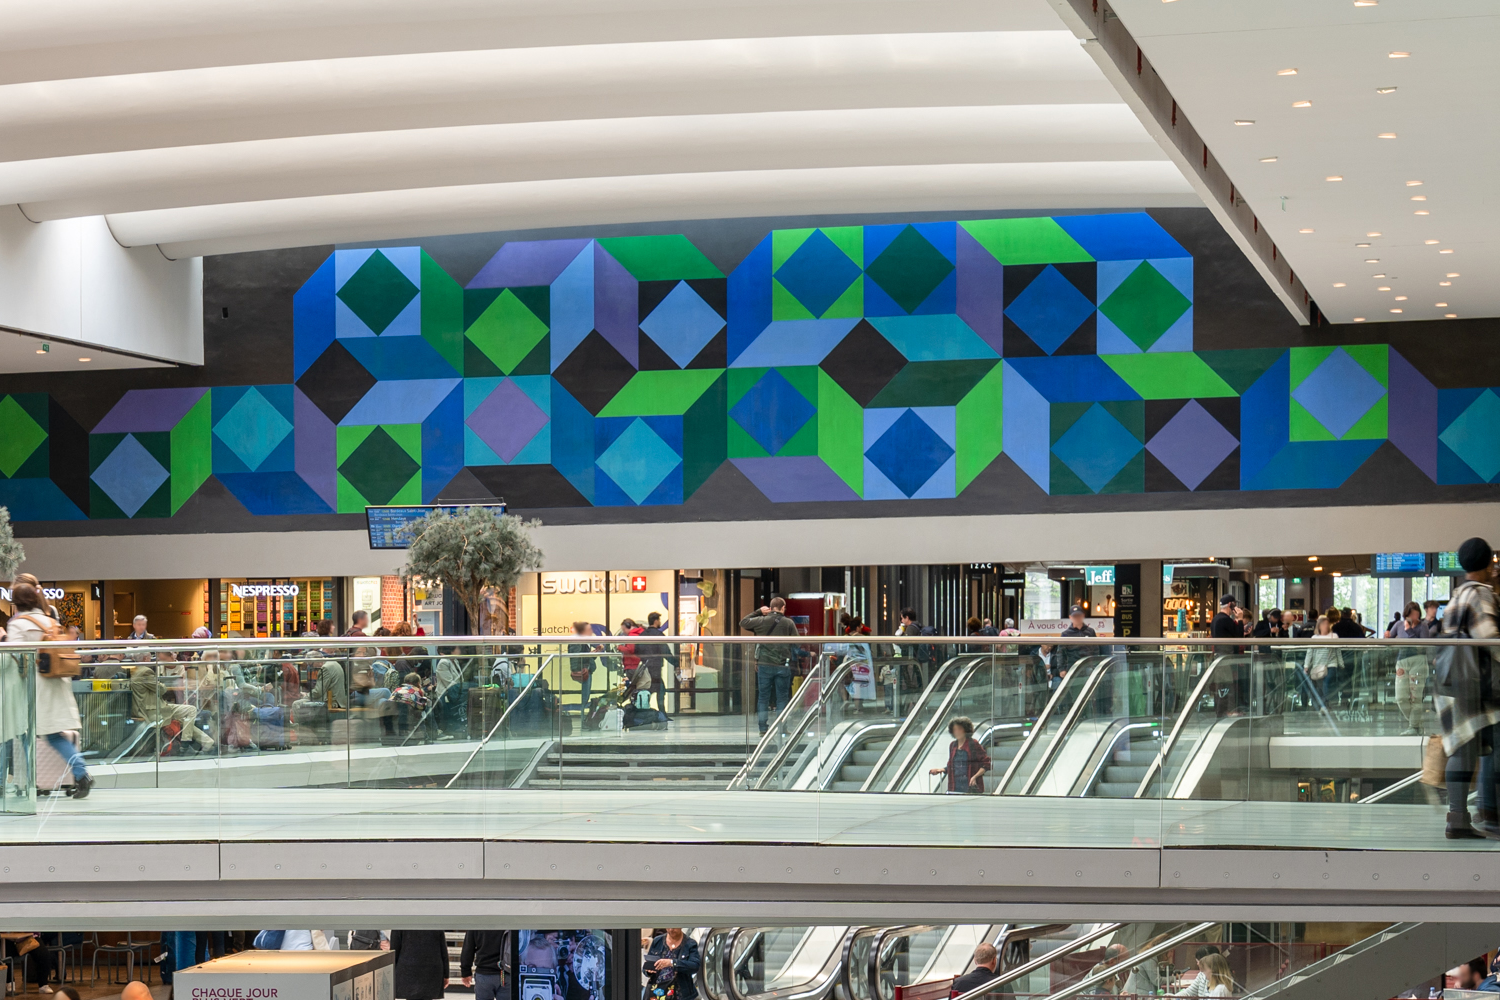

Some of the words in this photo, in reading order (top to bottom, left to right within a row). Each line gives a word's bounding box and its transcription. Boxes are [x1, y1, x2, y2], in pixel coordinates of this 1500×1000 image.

[1088, 570, 1112, 585] Jeff
[543, 574, 630, 594] swatch
[230, 584, 299, 598] NESPRESSO
[1028, 620, 1035, 629] À
[1057, 620, 1068, 629] de
[1123, 629, 1130, 637] P
[192, 988, 242, 998] CHAQUE
[246, 988, 278, 998] JOUR
